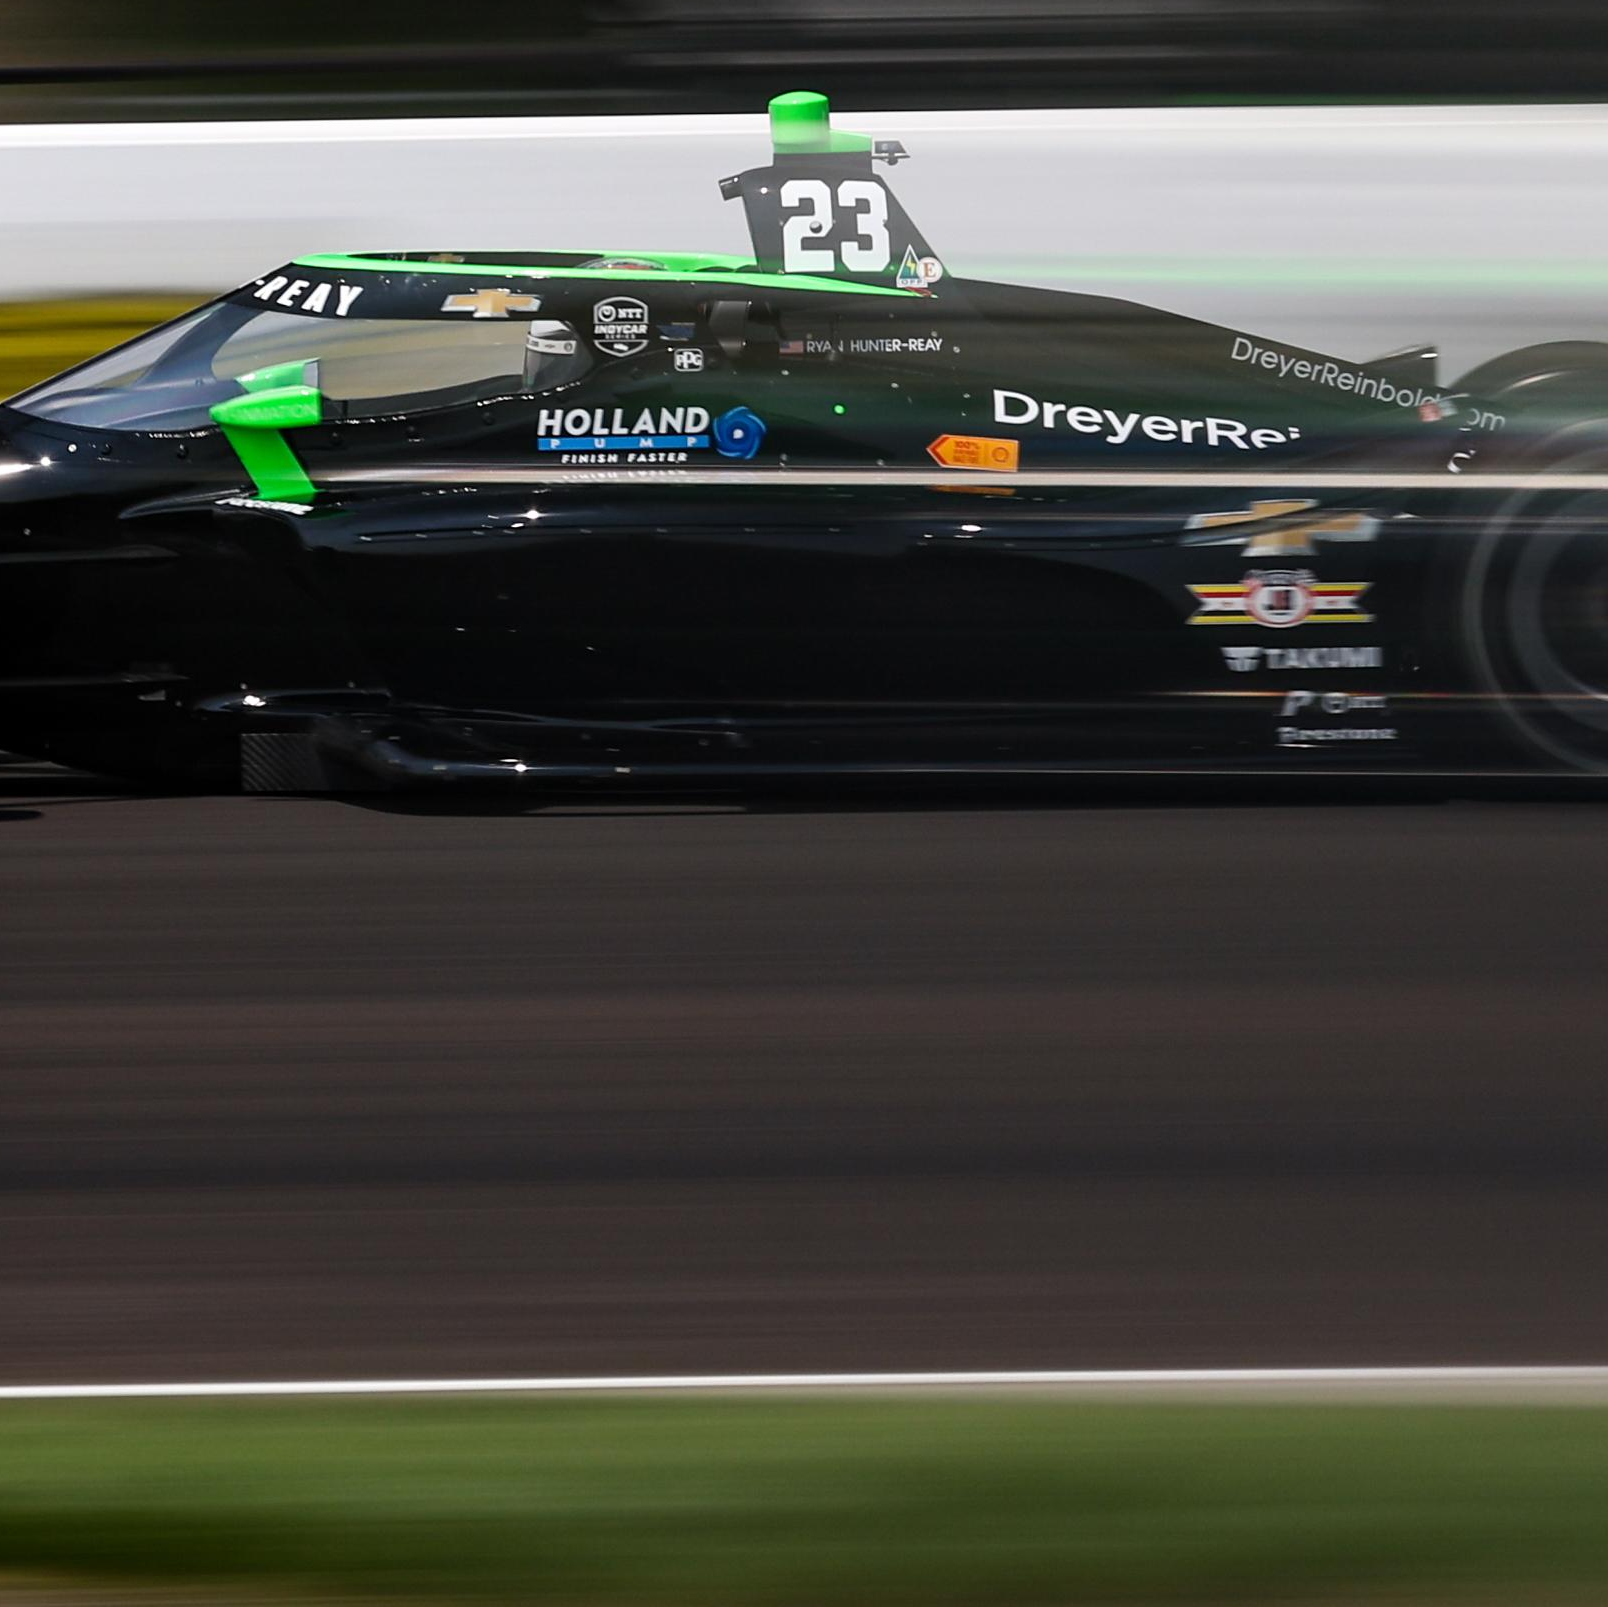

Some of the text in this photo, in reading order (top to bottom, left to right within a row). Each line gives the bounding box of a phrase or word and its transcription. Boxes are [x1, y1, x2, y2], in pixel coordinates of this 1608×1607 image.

[780, 179, 891, 273] 23
[924, 261, 937, 278] E
[253, 275, 364, 316] -REAY
[617, 308, 644, 319] NTT
[594, 324, 648, 334] INDYCAR
[850, 338, 943, 352] HUNTER-REAY
[676, 351, 703, 369] PPG
[537, 406, 710, 436] HOLLAND
[550, 436, 698, 449] PUMP
[561, 452, 688, 464] FINISH FASTER
